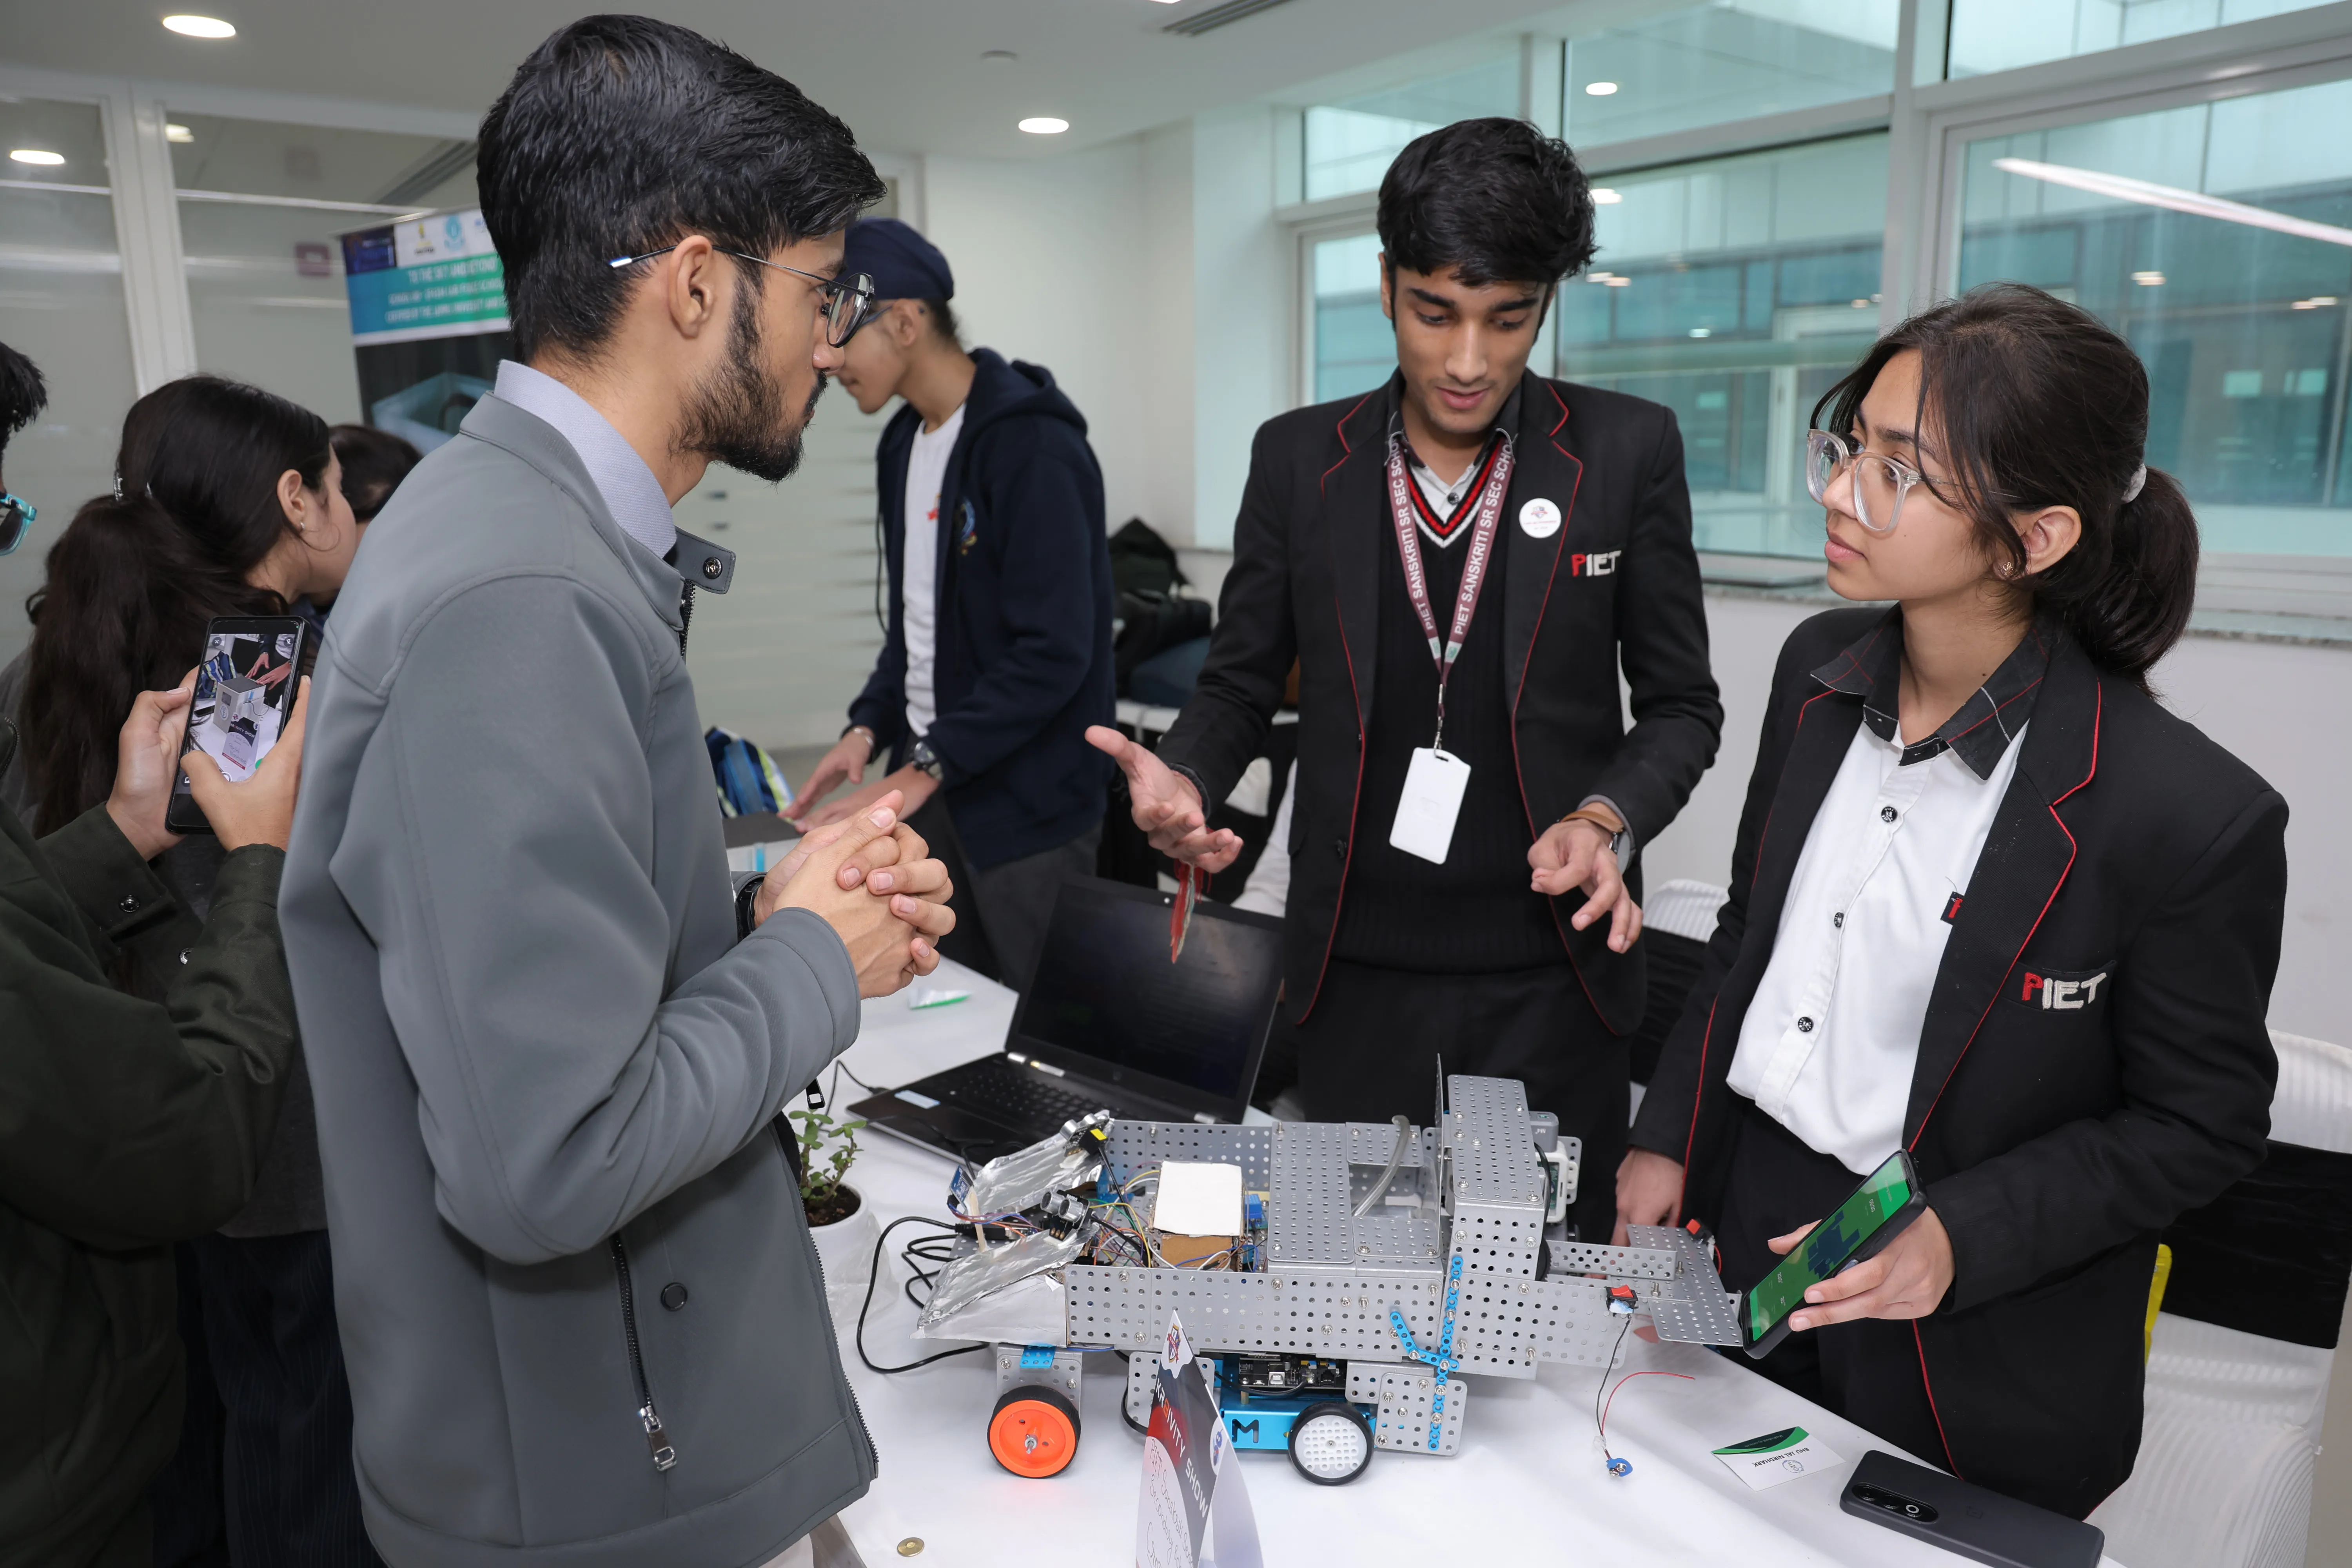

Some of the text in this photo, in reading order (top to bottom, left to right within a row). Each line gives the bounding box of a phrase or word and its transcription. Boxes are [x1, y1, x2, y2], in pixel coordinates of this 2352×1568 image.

[1390, 439, 1434, 630] PIET SANSKRITI SR SEC SCHO
[1454, 444, 1512, 635] PIET SANSKRITI SR SEC SCHO
[1571, 550, 1622, 577] PIET
[2022, 972, 2107, 1010] PIET
[1150, 1439, 1163, 1479] PIET
[1752, 1455, 1785, 1467] NIRDHARK
[1185, 1457, 1209, 1518] SHOW
